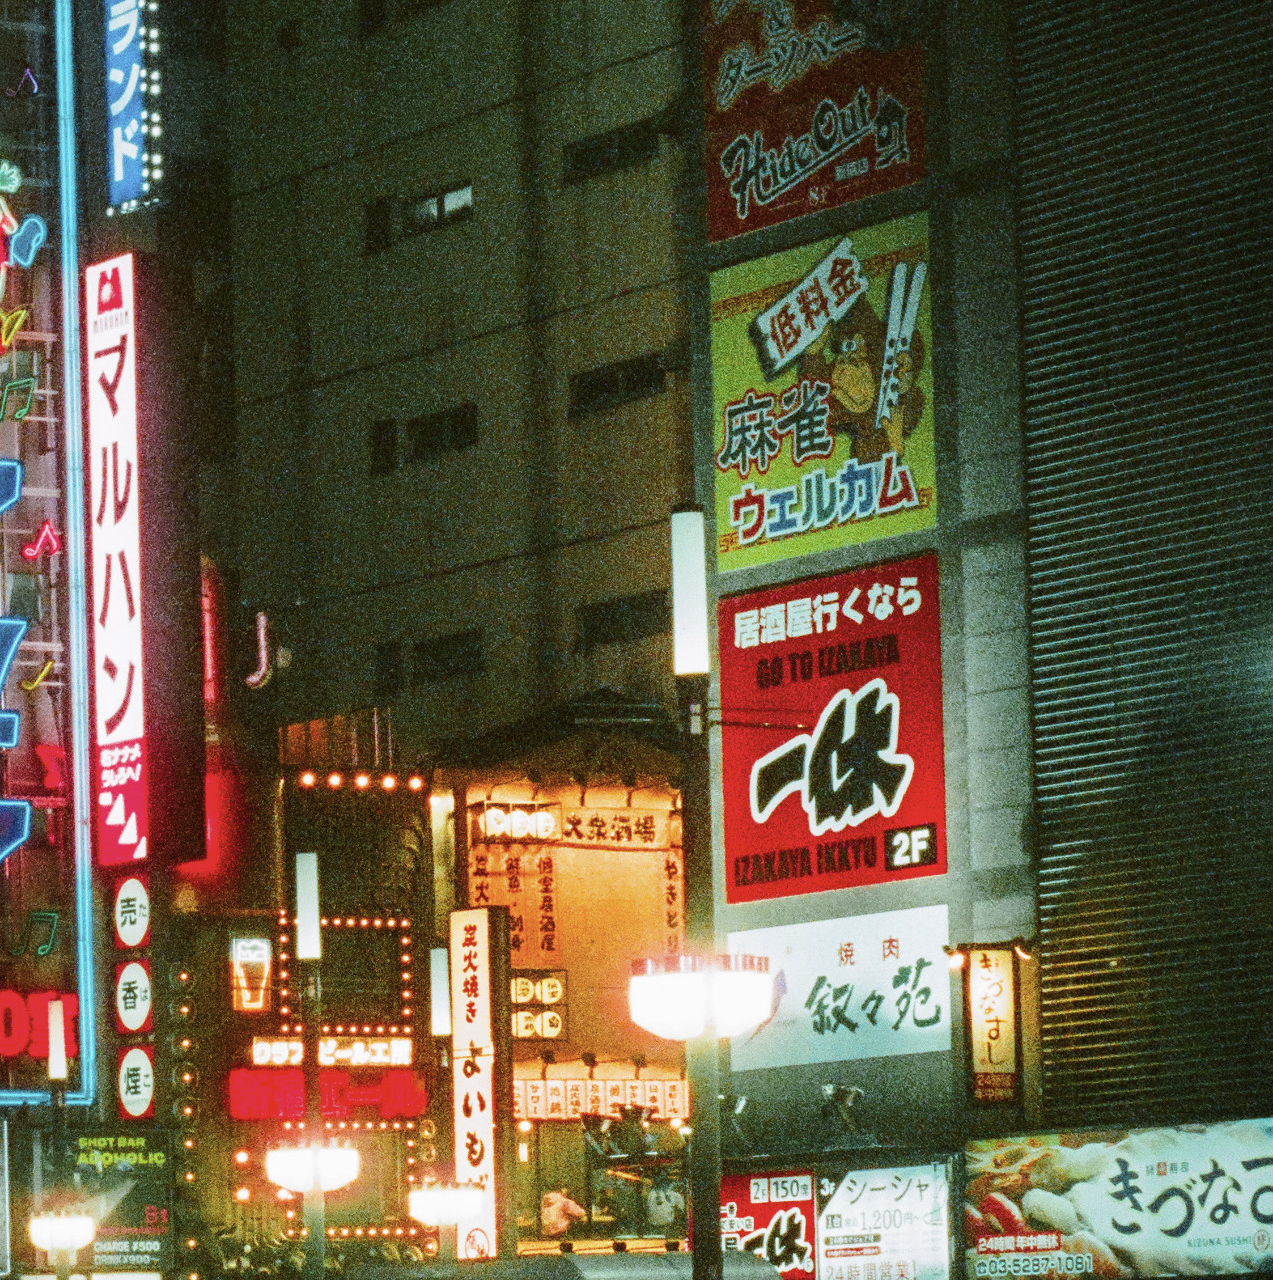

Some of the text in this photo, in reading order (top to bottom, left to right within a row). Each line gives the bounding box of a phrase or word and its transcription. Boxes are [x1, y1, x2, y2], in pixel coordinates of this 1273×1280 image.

[769, 256, 861, 360] 低料金
[718, 380, 835, 477] 麻雀
[93, 334, 139, 737] マルハン
[733, 576, 923, 649] 居酒屋行くなら
[756, 634, 900, 689] GO TO IZAKAYA
[749, 677, 915, 837] 一休
[563, 813, 656, 842] 大衆酒場
[734, 829, 931, 887] IZAKAYA IKKYU 2F
[804, 957, 942, 1035] 叙々苑
[462, 1040, 488, 1190] よいも
[846, 1175, 930, 1205] シーシャ
